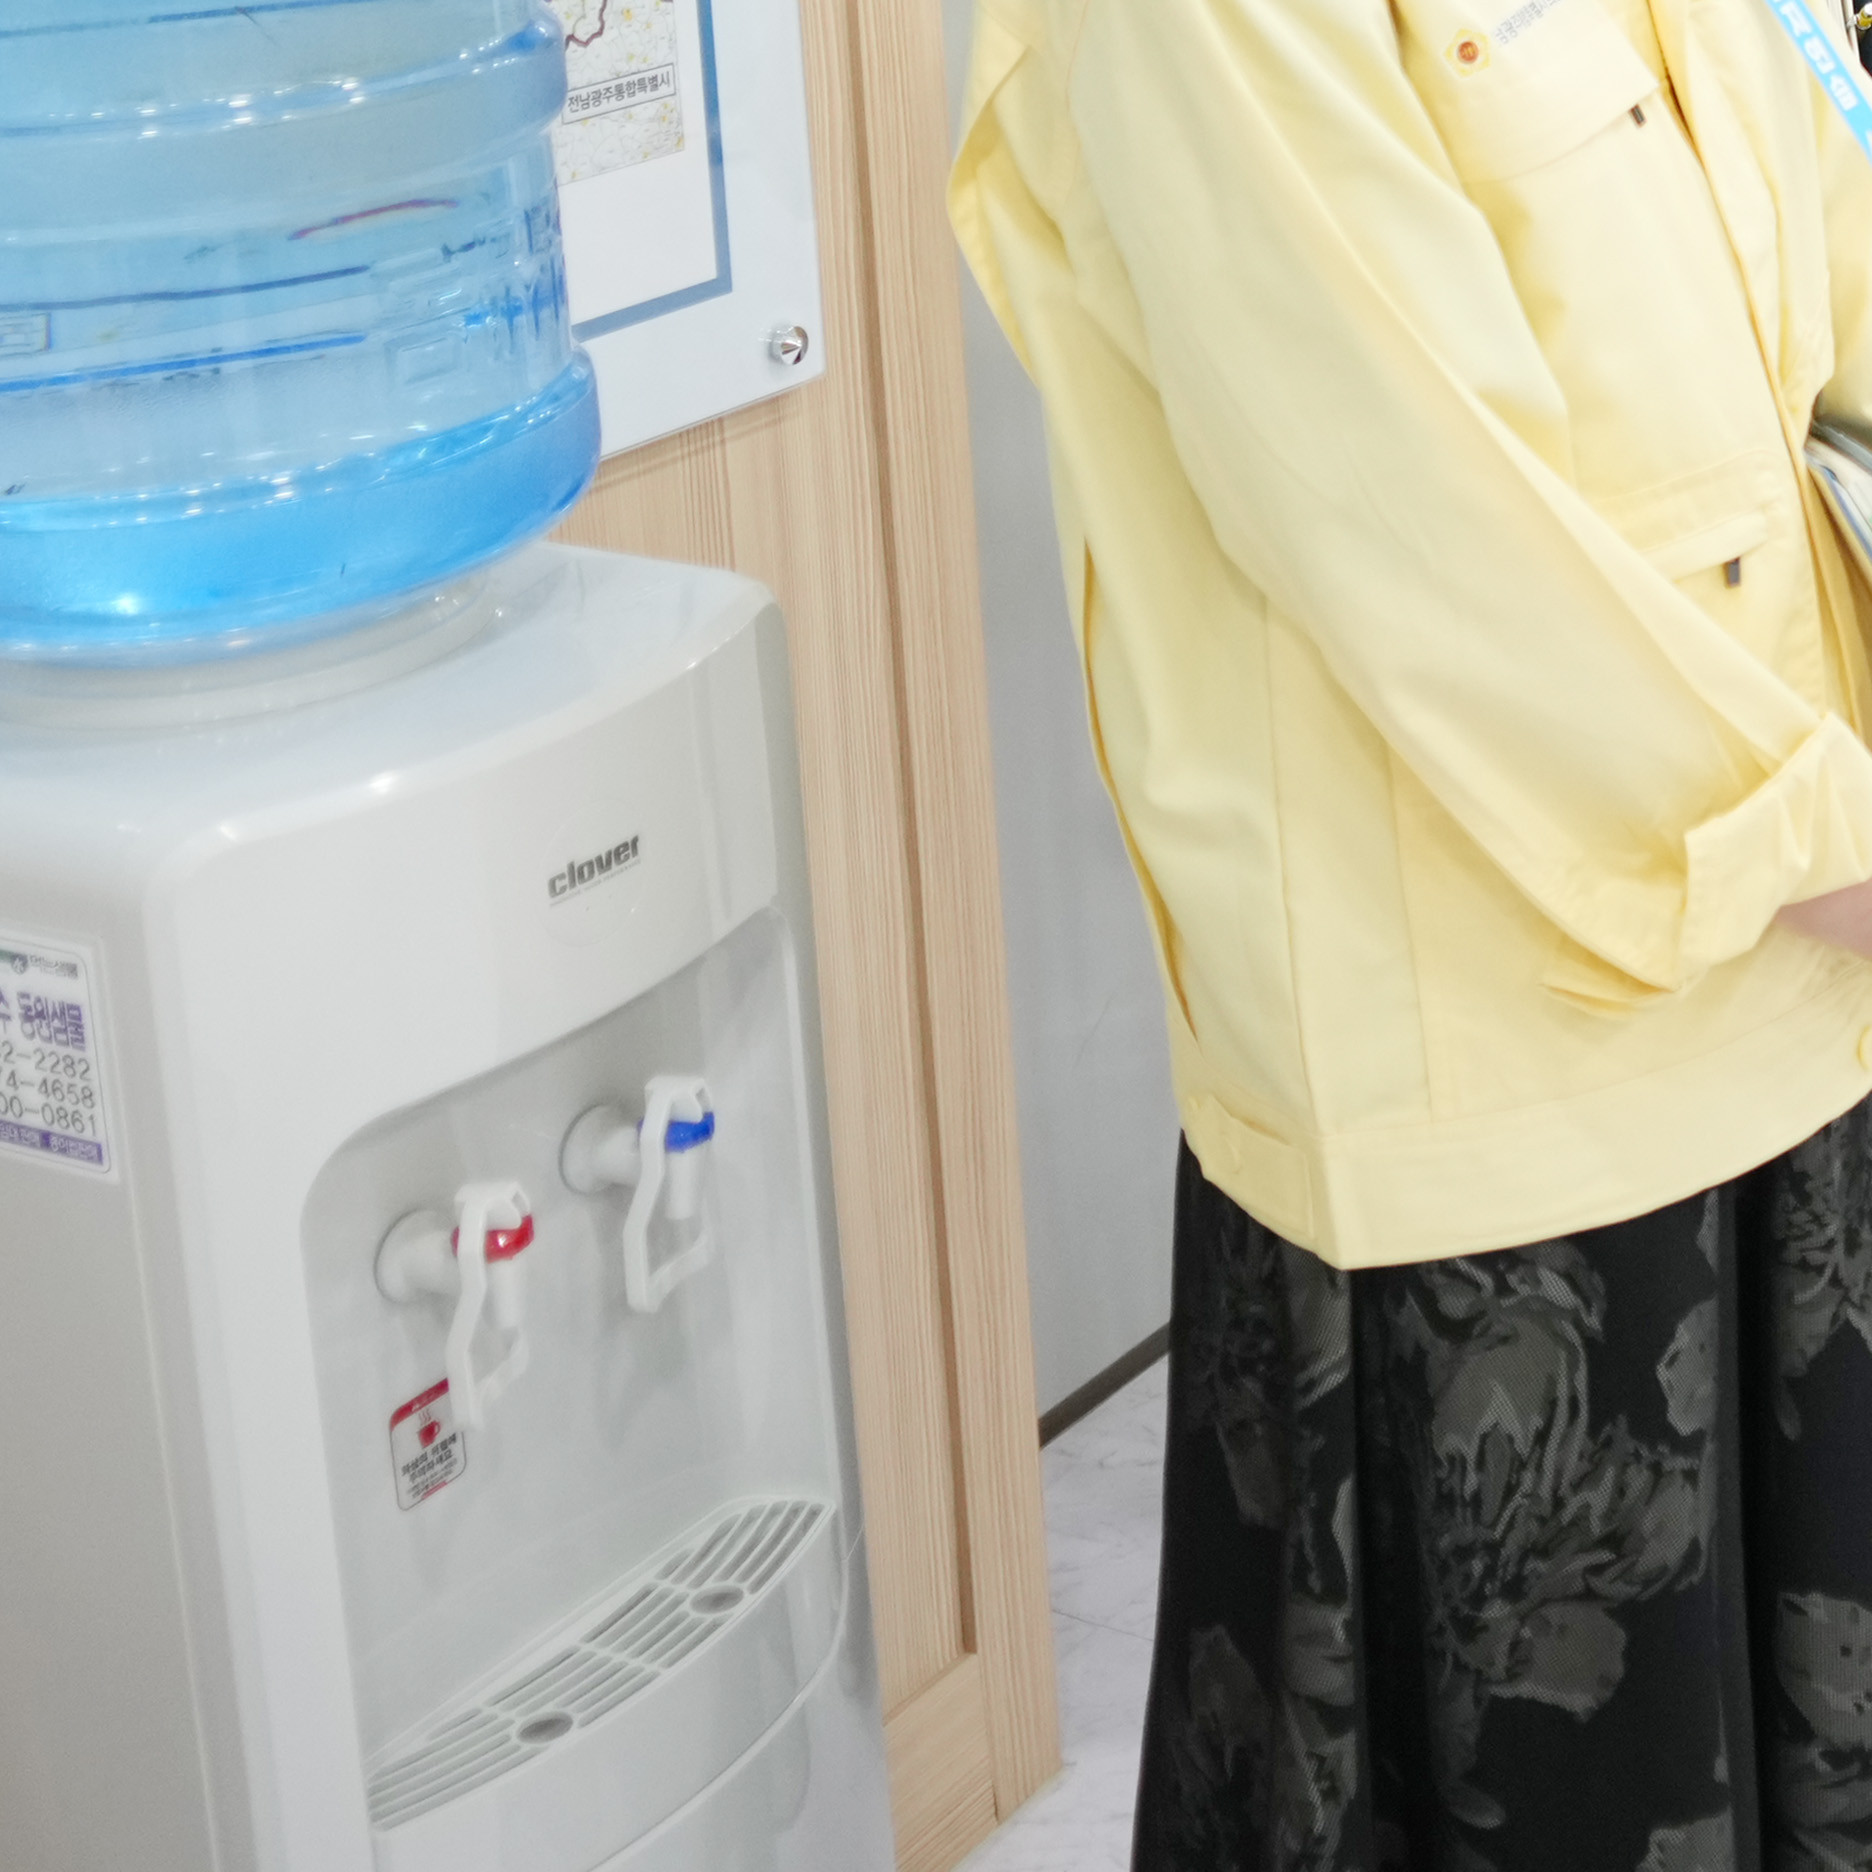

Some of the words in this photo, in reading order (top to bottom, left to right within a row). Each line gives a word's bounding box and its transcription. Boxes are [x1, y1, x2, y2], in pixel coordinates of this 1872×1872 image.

[567, 71, 672, 115] 전남광주통합특별시
[547, 834, 640, 899] clover
[0, 1039, 91, 1083] 2-2282
[0, 1066, 95, 1110] 4-4658
